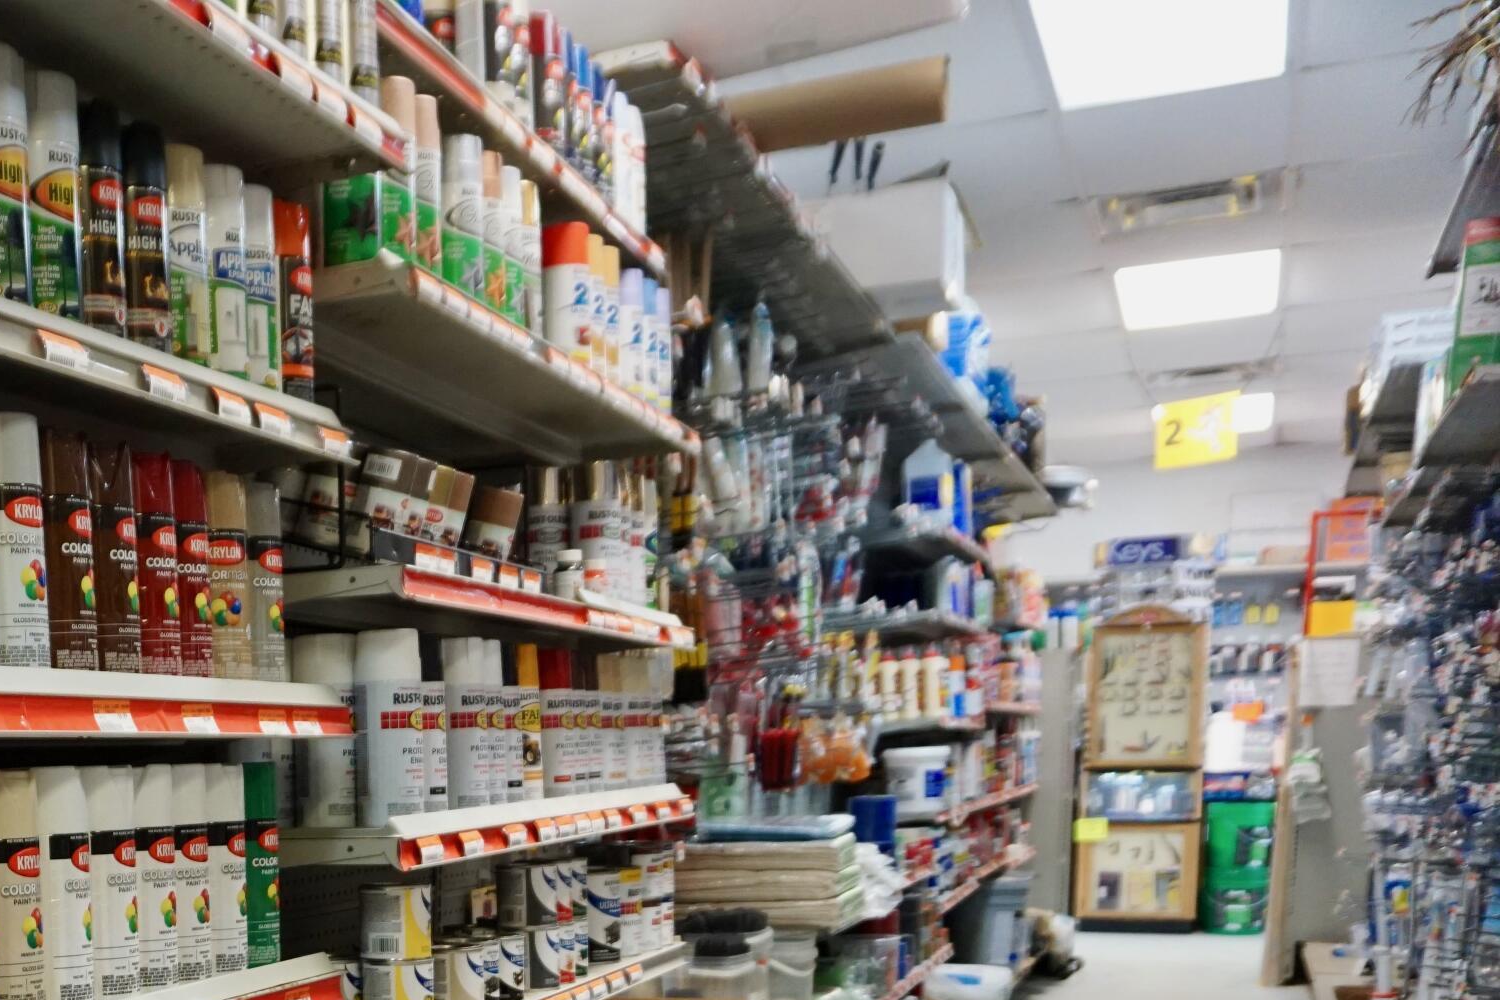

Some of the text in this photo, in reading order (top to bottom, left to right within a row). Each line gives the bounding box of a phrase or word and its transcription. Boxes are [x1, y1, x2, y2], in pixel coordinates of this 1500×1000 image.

[138, 201, 165, 217] KRYL
[128, 236, 155, 250] HIGH
[1164, 420, 1182, 447] 2
[13, 898, 32, 906] PAINT
